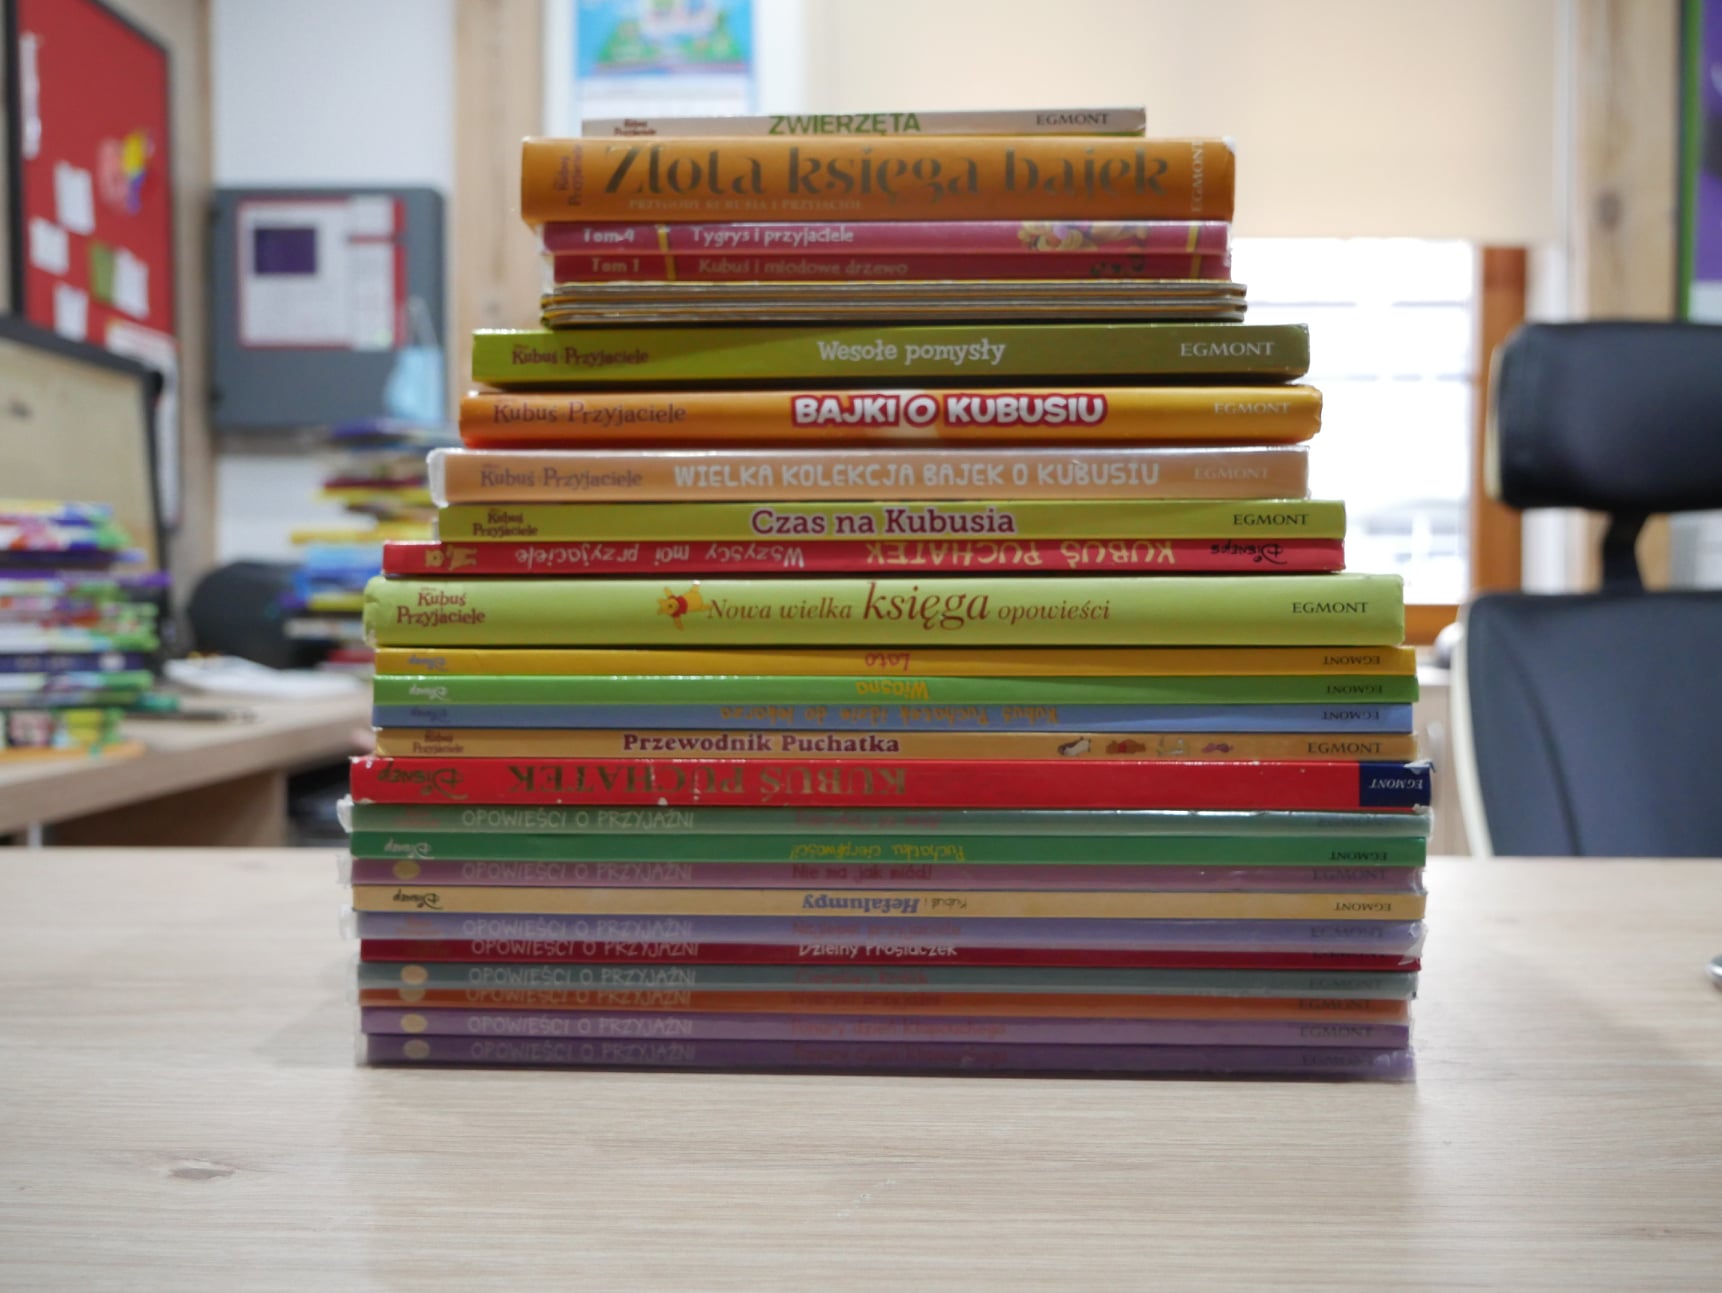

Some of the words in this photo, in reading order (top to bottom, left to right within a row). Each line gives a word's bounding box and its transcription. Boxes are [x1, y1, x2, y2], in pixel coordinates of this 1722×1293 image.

[768, 112, 921, 136] ZWIERZĘTA
[1036, 112, 1110, 126] EGMONT
[788, 146, 980, 204] księga
[1004, 146, 1170, 197] bajek
[1191, 140, 1205, 213] EGMONT
[584, 228, 619, 243] Tom
[622, 228, 636, 243] 4
[692, 228, 750, 247] Tygrys
[763, 225, 855, 248] przyjaciele
[591, 259, 629, 273] Tom
[698, 258, 751, 274] Kubuś
[764, 259, 842, 275] miodowe
[511, 348, 559, 365] Kubuś
[564, 347, 650, 367] Przyjaciele
[816, 338, 898, 361] Wesołe
[904, 338, 1006, 366] pomysły
[1180, 341, 1276, 357] EGMONT
[492, 402, 558, 424] Kubuś
[567, 401, 687, 428] Przyjaciele
[793, 395, 897, 424] BAJKI
[907, 396, 937, 423] O
[945, 394, 1106, 424] KUBUSIU
[1213, 401, 1292, 415] EGMONT
[479, 466, 535, 487] Kubuś
[541, 466, 643, 491] Przyjaciele
[674, 465, 775, 488] WIELKA
[782, 463, 915, 488] KOLEKCJA
[922, 463, 1005, 486] BAJEK
[1011, 463, 1028, 486] O
[1037, 461, 1161, 486] KUBUSIU
[1193, 466, 1270, 480] EGMONT
[750, 507, 826, 535] Czas
[834, 512, 876, 534] na
[883, 506, 1017, 535] Kubusia
[1233, 513, 1310, 527] EGMONT
[514, 543, 640, 567] przyjaciele
[652, 545, 691, 567] moi
[704, 543, 806, 568] Wszyscy
[866, 541, 1044, 566] PUCHATEK
[1060, 540, 1177, 569] KUBUŚ
[417, 591, 467, 607] Kubuś
[707, 599, 772, 620] Nowa
[779, 597, 853, 620] wielka
[862, 581, 991, 631] księga
[997, 599, 1111, 626] opowieści
[1292, 601, 1369, 615] EGMONT
[396, 606, 487, 628] Przyjaciele
[864, 652, 911, 672] Lato
[1322, 655, 1381, 666] EGMONT
[409, 682, 452, 700] Disney
[1326, 684, 1383, 695] EGMONT
[804, 706, 829, 724] do
[839, 706, 889, 724] idzie
[899, 706, 991, 725] Puchatek
[1002, 706, 1060, 725] Kubuś
[1321, 710, 1381, 721] EGMONT
[623, 733, 773, 752] Przewodnik
[780, 733, 900, 753] Puchatka
[1307, 742, 1383, 754] EGMONT
[377, 761, 469, 800] Disney
[506, 764, 746, 795] PUCHATEK
[759, 766, 908, 803] KUBUŚ
[1368, 778, 1424, 790] EGMONT
[461, 806, 566, 828] OPOWIEŚCI
[575, 809, 589, 826] O
[597, 806, 694, 829] PRZYJAŹNI
[383, 838, 436, 860] Disney
[1330, 851, 1388, 862] EGMONT
[461, 859, 566, 880] OPOWIEŚCI
[574, 862, 588, 879] O
[596, 860, 693, 882] PRZYJAŹNI
[393, 887, 444, 910] Disney
[801, 893, 921, 914] Hefalumpy
[1335, 902, 1392, 912] EGMONT
[462, 916, 567, 938] OPOWIEŚCI
[574, 919, 588, 936] O
[468, 965, 571, 987] OPOWIEŚCI
[579, 968, 593, 985] O
[600, 966, 697, 989] PRZYJAŹNI
[467, 1013, 569, 1035] OPOWIEŚCI
[578, 1016, 592, 1034] O
[598, 1014, 693, 1037] PRZYJAŹNI
